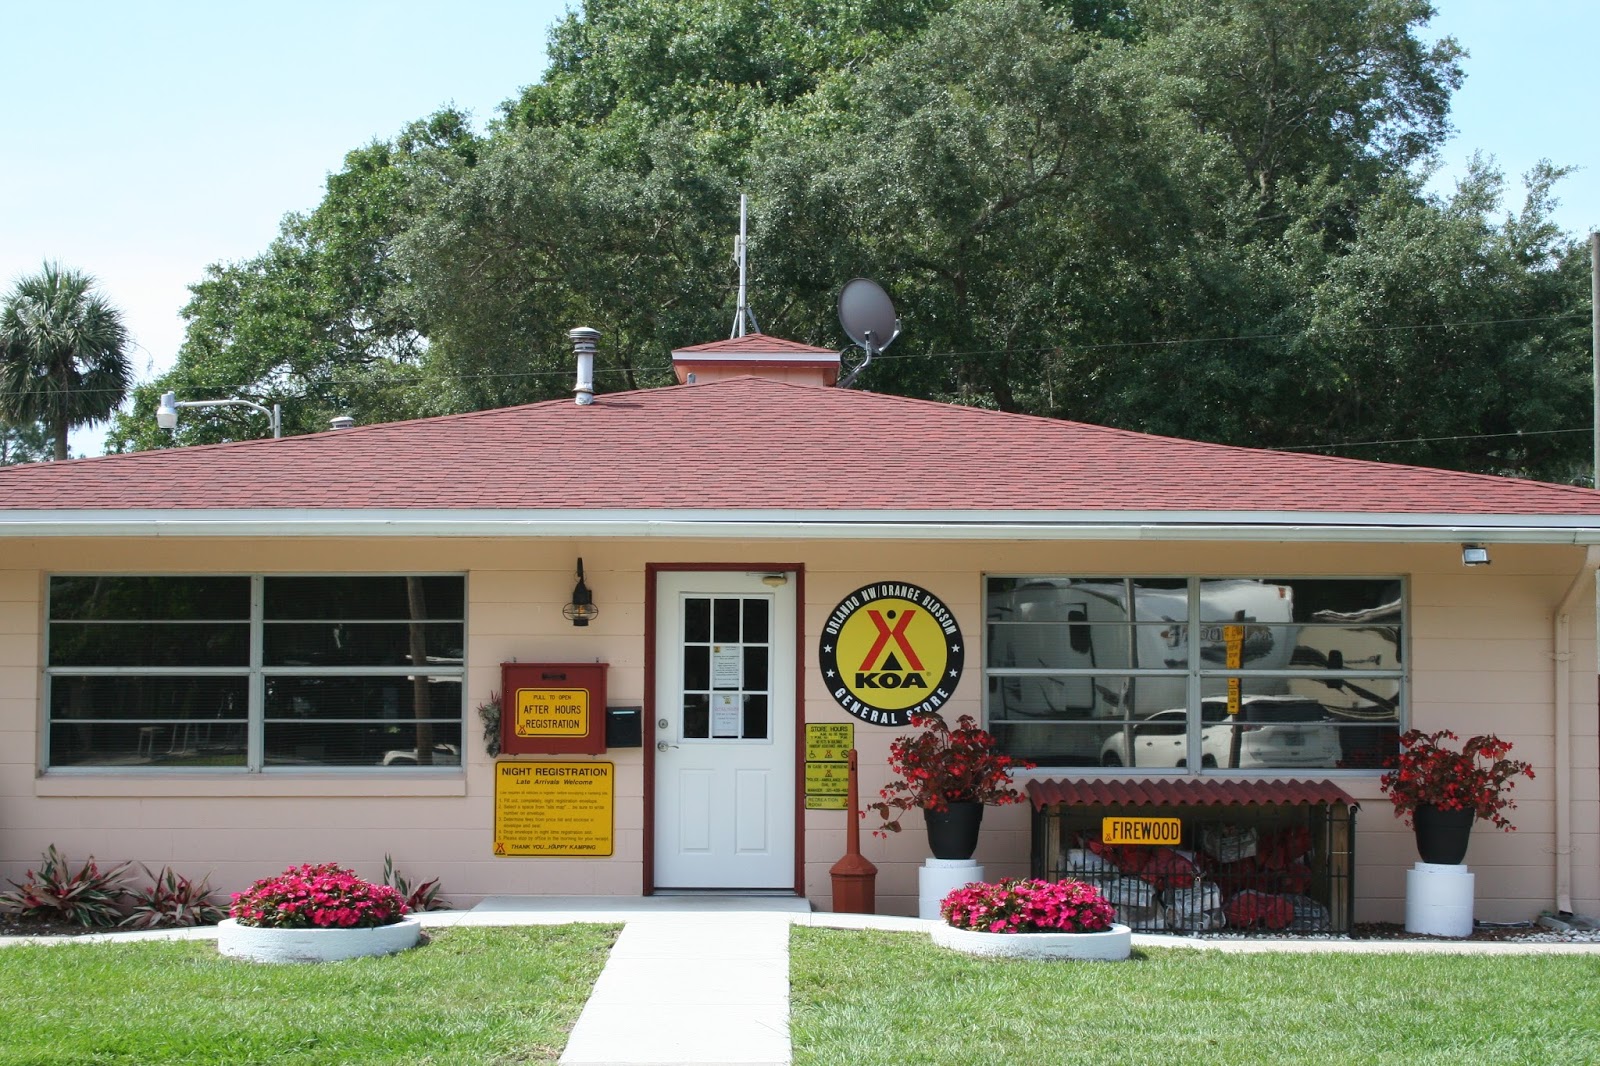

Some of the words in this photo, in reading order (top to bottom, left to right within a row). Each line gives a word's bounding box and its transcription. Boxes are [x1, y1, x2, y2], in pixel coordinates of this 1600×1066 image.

[826, 596, 860, 635] ORLANDO
[861, 584, 921, 601] NW/ORANGE
[921, 595, 957, 635] BLOSSOM
[855, 672, 928, 688] KOA
[524, 705, 549, 714] AFTER
[555, 705, 581, 714] HOURS
[834, 687, 898, 724] GENERAL
[526, 719, 580, 729] REGISTRATION
[502, 767, 532, 776] NIGHT
[535, 767, 608, 776] REGISTRATION
[1113, 821, 1179, 840] FIREWOOD
